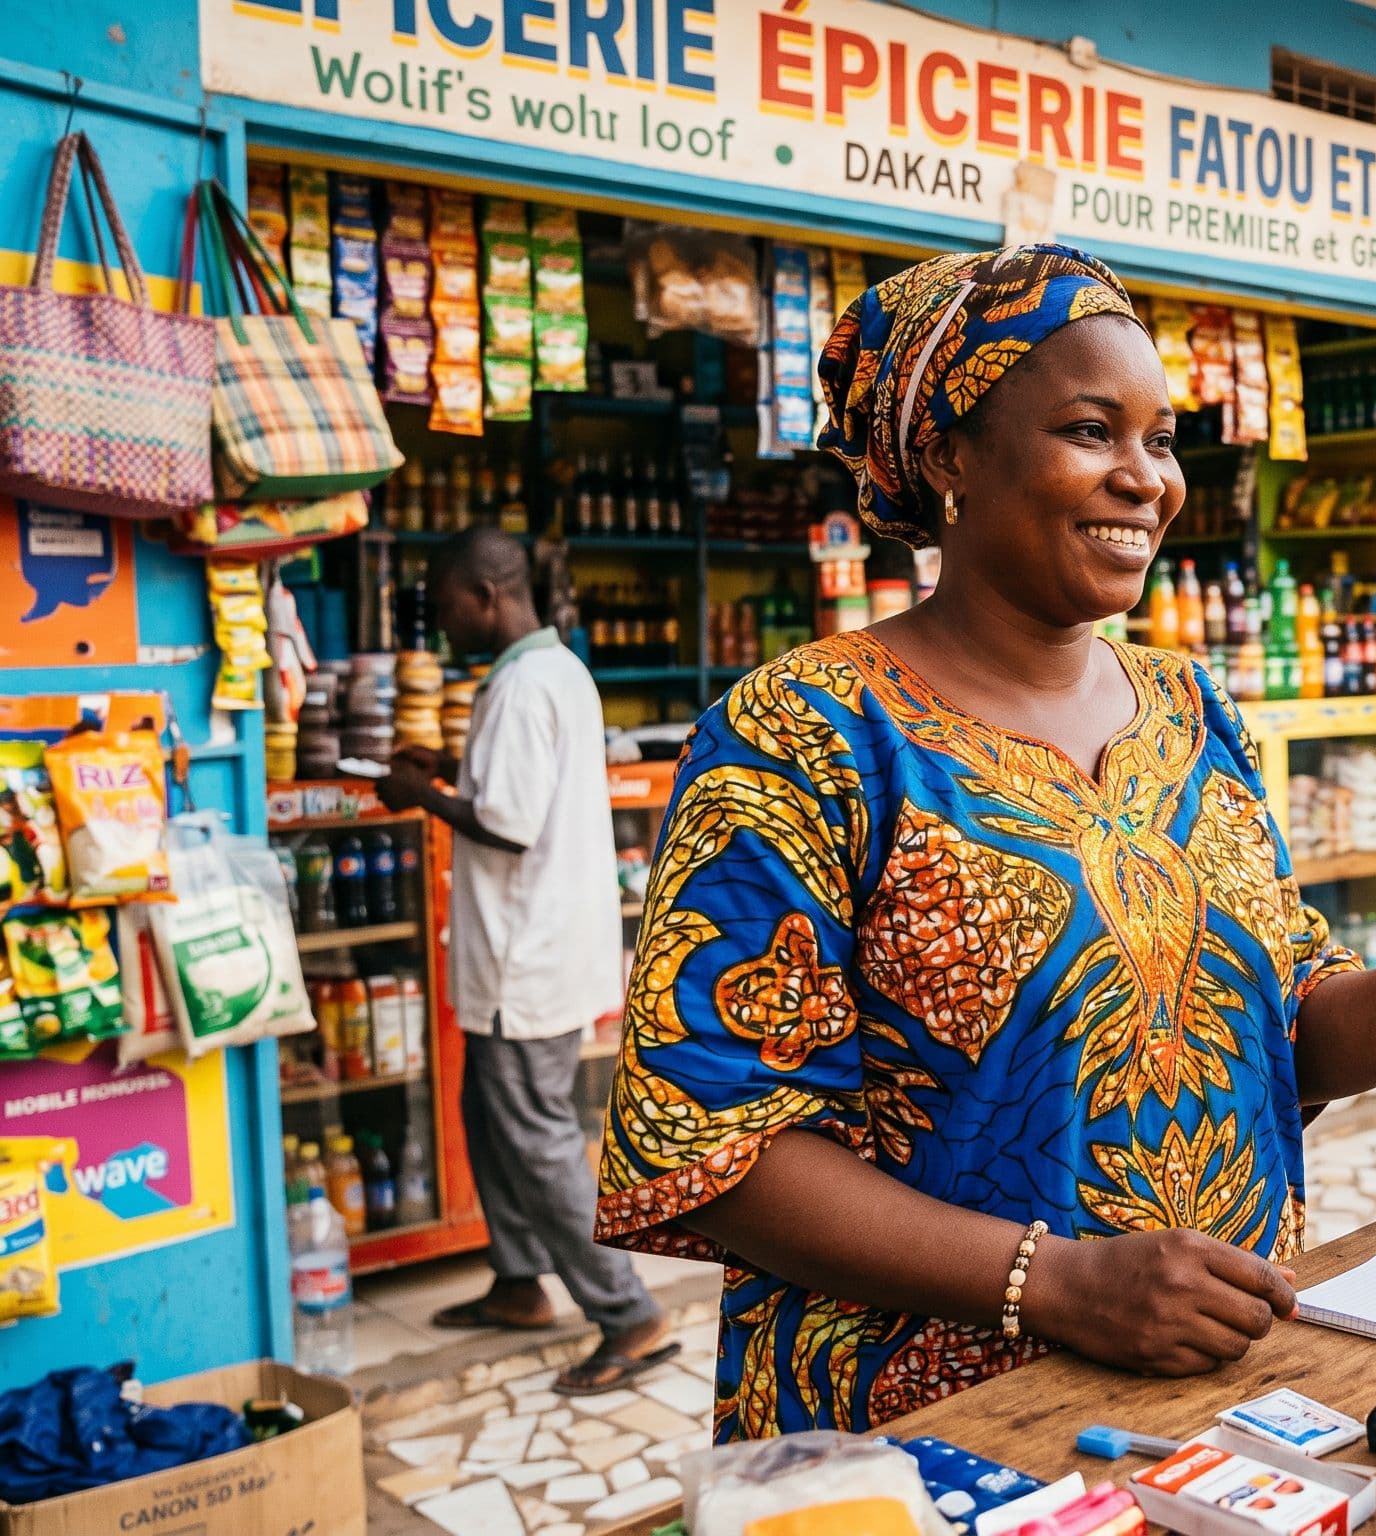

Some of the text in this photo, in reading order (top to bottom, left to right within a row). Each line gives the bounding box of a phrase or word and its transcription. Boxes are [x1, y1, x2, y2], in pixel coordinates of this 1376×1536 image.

[232, 0, 718, 100] ERIE
[760, 0, 1144, 178] ÉPICERIE
[1171, 105, 1314, 208] FATOU
[311, 45, 491, 121] Wolif's
[641, 104, 735, 160] loof
[845, 142, 982, 202] DAKAR
[1072, 183, 1154, 231] POUR
[1312, 231, 1339, 262] et
[77, 763, 147, 789] RIZ
[4, 1087, 79, 1120] MOBILE
[73, 1149, 168, 1193] wave
[119, 1495, 200, 1533] CANON
